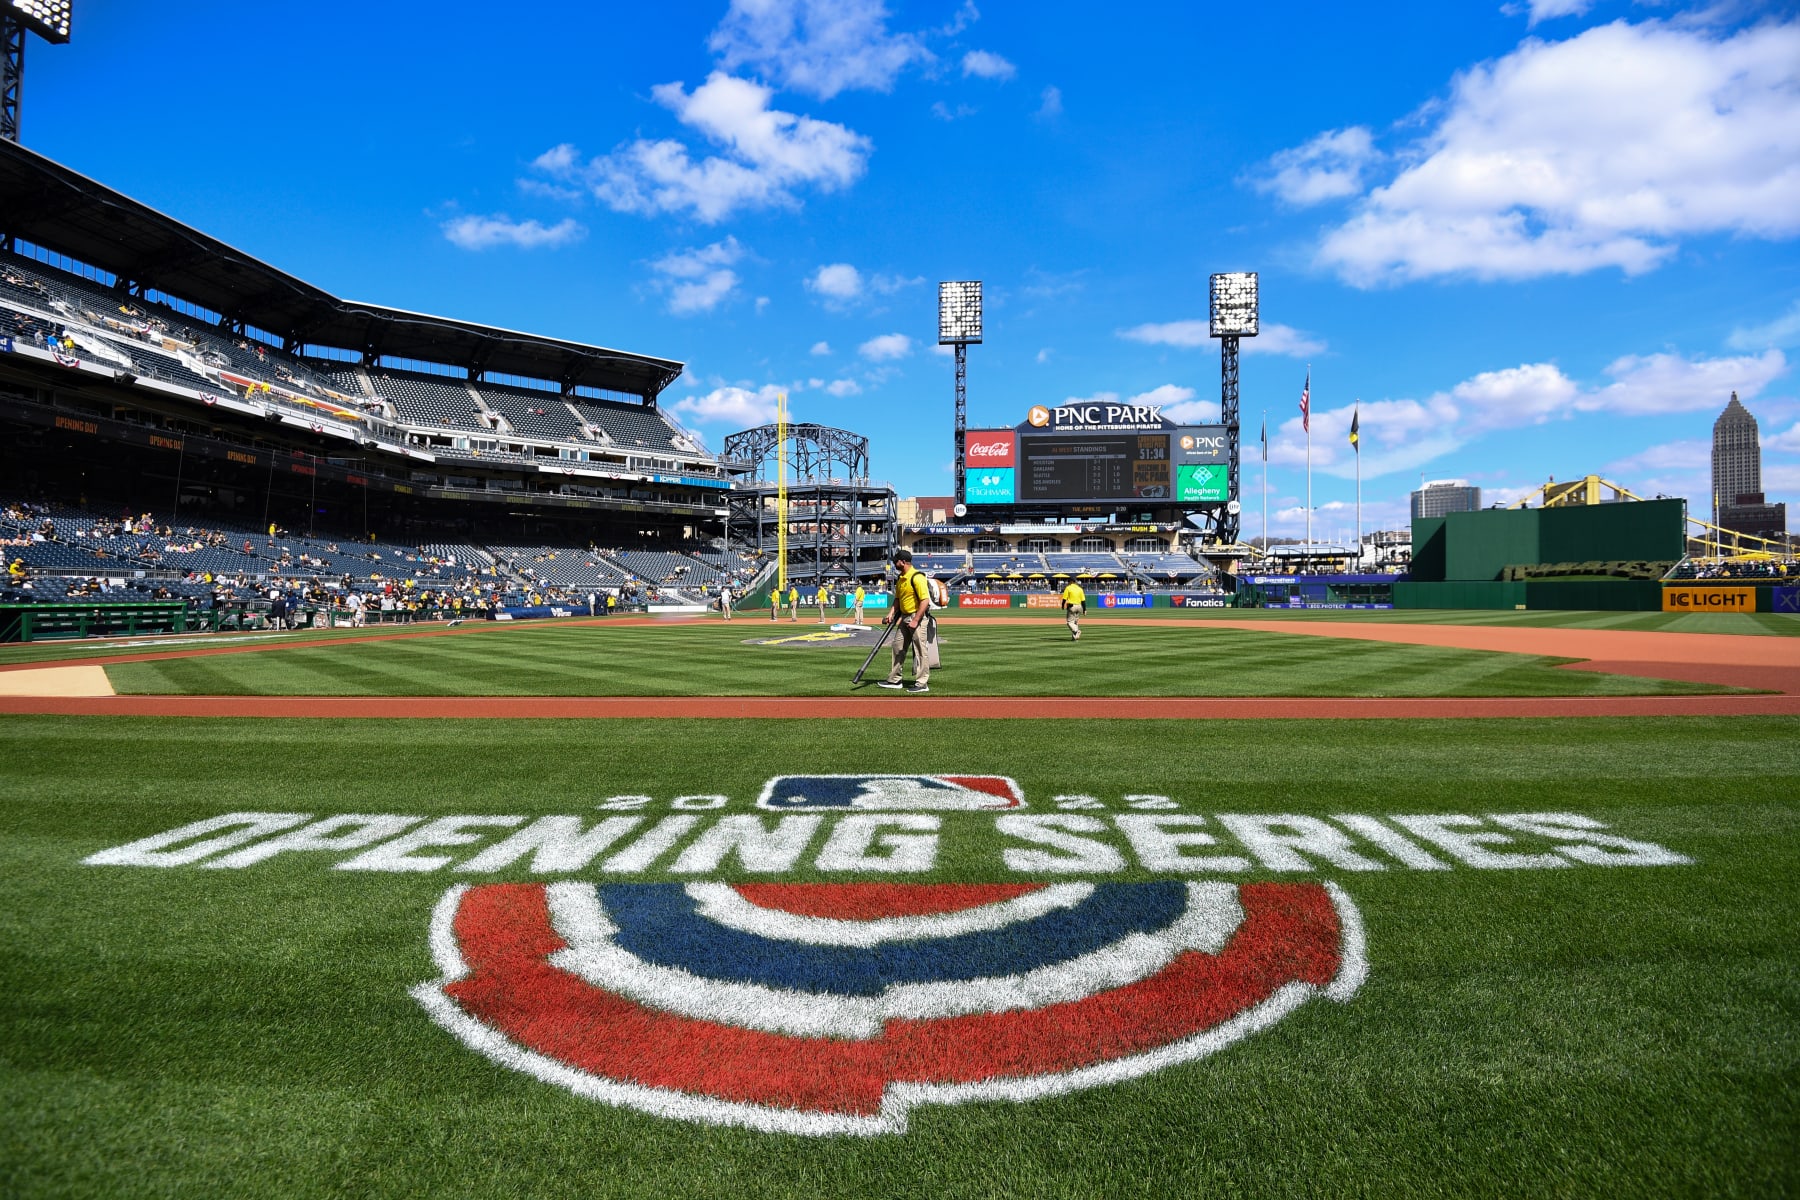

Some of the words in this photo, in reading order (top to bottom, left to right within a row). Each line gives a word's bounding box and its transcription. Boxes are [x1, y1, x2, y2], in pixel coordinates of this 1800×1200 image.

[1053, 407, 1101, 424] PNC
[1105, 405, 1163, 422] PARK
[55, 416, 84, 432] OPENING
[84, 421, 98, 435] DAY
[149, 435, 173, 449] OPENING
[1195, 436, 1225, 448] PNC
[969, 442, 1012, 457] Coca-Cola
[1140, 448, 1164, 460] 51:34
[1184, 487, 1220, 496] Allegheny
[1186, 598, 1224, 607] Fanatics
[1693, 593, 1748, 606] LIGHT
[596, 794, 729, 811] 20
[1053, 794, 1181, 810] 22
[83, 812, 941, 874] OPENING
[1000, 811, 1694, 873] SERIES
